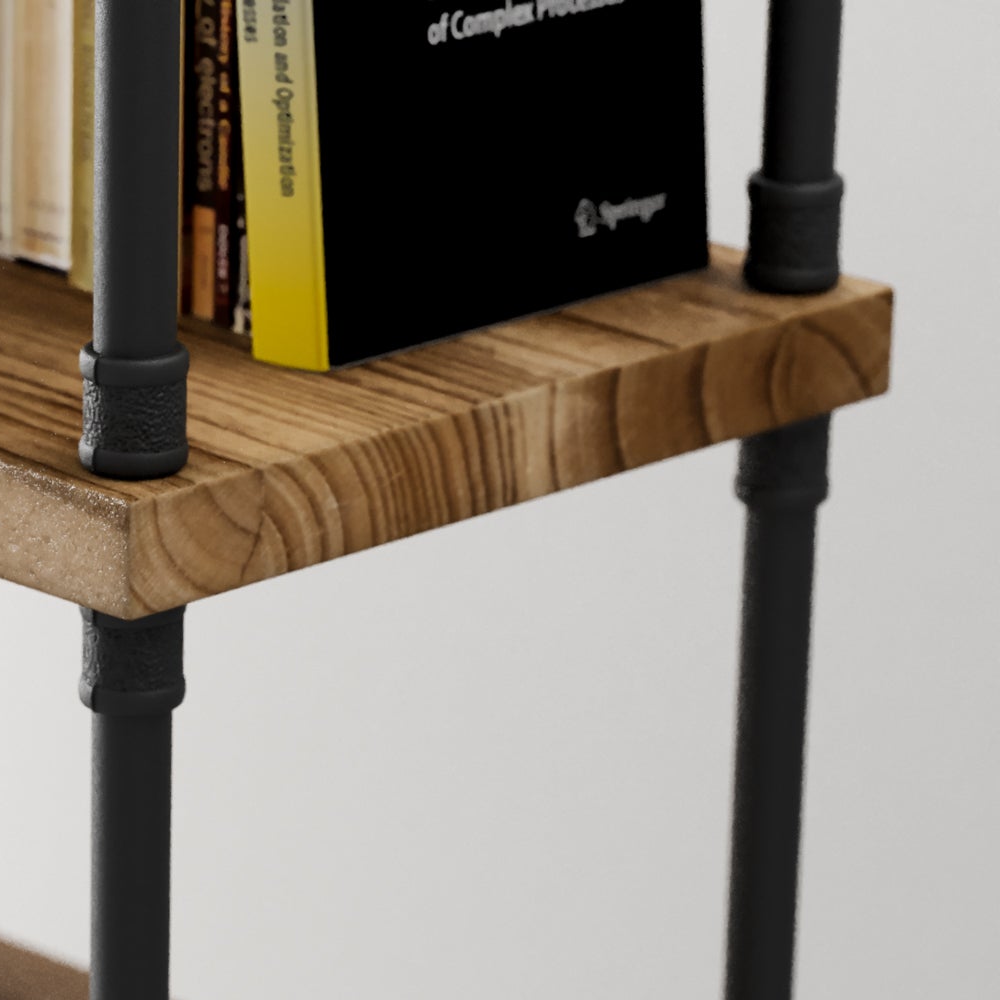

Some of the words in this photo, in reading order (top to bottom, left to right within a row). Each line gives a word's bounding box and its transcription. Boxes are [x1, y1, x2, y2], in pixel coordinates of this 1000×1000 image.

[427, 12, 449, 45] of
[451, 0, 535, 40] Complex
[274, 52, 293, 84] and
[271, 87, 297, 198] Optimization
